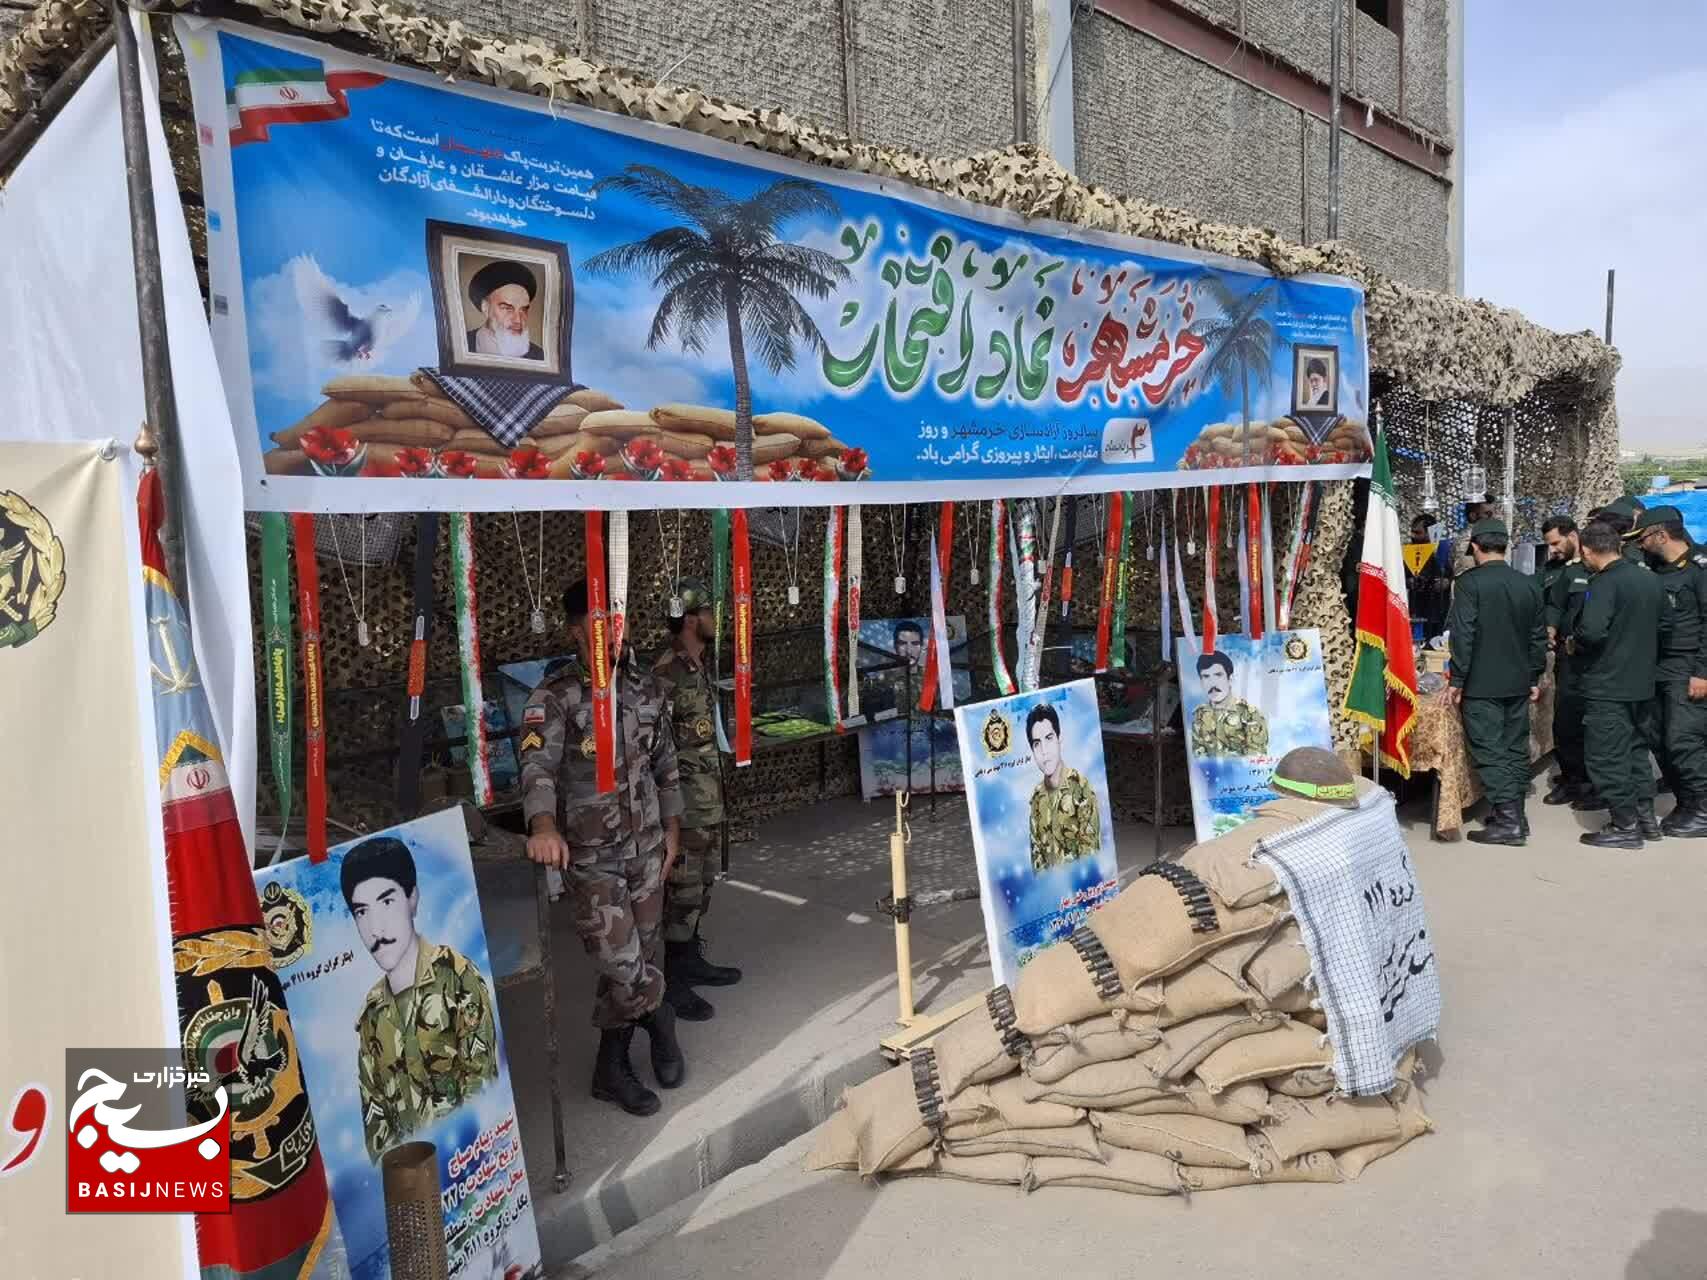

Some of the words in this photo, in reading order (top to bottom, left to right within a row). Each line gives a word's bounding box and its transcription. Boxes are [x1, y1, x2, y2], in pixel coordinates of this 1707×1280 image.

[370, 118, 384, 133] تا
[384, 124, 403, 138] که
[403, 130, 439, 146] است
[376, 146, 384, 157] و
[389, 146, 446, 169] عارفان
[378, 166, 430, 188] آزادگان
[449, 164, 457, 175] و
[461, 162, 523, 185] عاشقان
[526, 174, 550, 190] مزار
[553, 183, 598, 201] قیامت
[515, 194, 596, 220] دلسوختگان
[917, 420, 939, 439] روز
[941, 425, 949, 439] و
[951, 420, 1008, 440] خرمشهر
[941, 440, 980, 466] گرامی
[981, 447, 1023, 466] پیروزی
[1023, 450, 1031, 463] و
